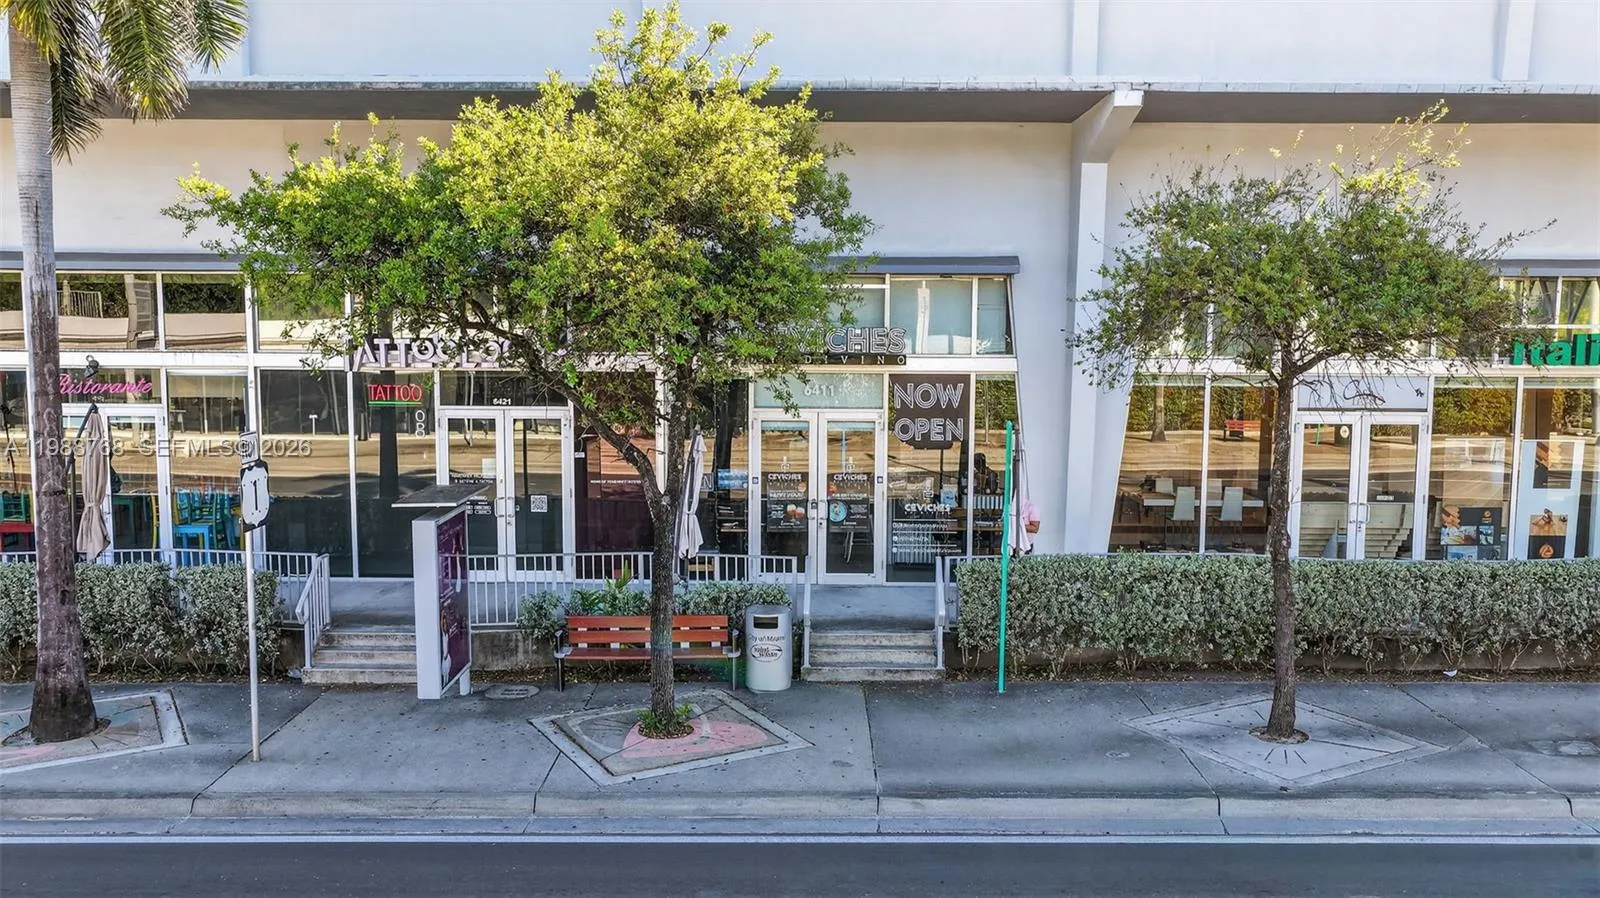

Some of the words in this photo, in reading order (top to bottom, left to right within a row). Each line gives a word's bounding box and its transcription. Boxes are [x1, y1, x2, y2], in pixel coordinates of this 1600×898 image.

[804, 354, 906, 366] DIVINO
[59, 373, 153, 395] Ristorante
[367, 384, 423, 402] TATTOO
[803, 385, 834, 398] 6411
[892, 383, 965, 409] NOW
[893, 418, 964, 442] OPEN
[833, 473, 868, 481] CEVICHES
[253, 480, 258, 511] 1
[904, 503, 951, 512] CEVICHES
